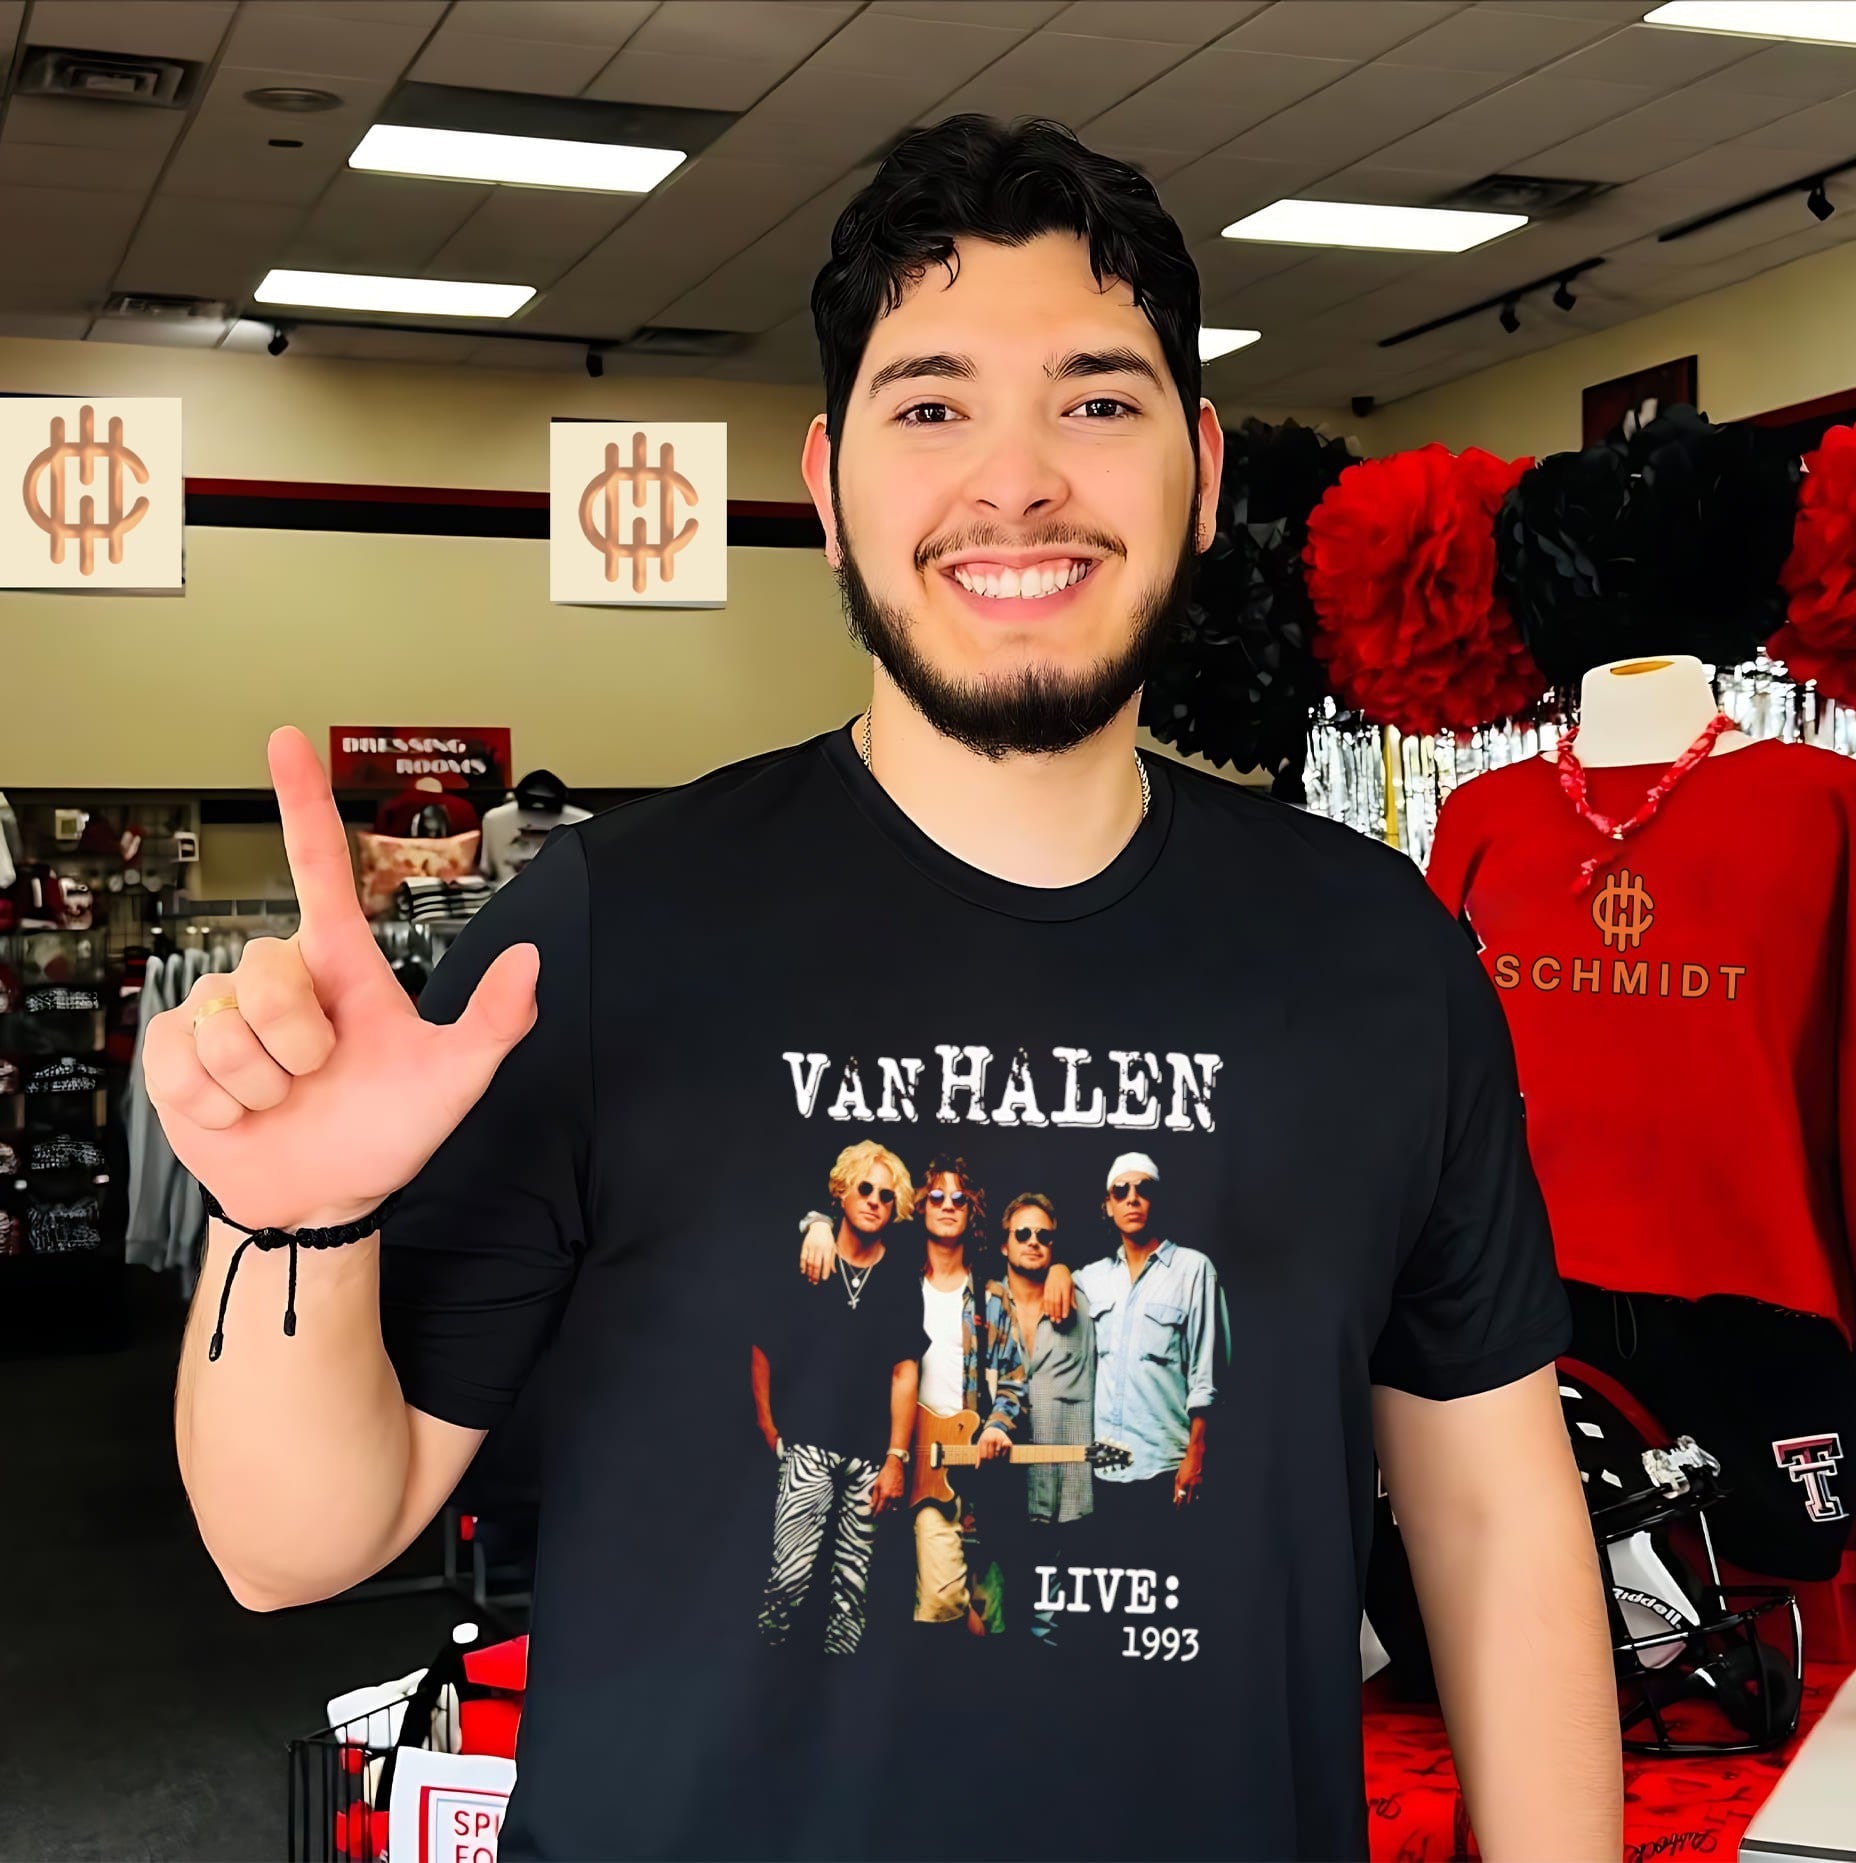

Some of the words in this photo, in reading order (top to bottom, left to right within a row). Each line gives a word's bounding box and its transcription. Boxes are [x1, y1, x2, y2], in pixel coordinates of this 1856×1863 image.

[342, 737, 466, 754] DRESSING
[396, 758, 487, 775] ROOMS
[1494, 954, 1747, 1001] SCHMIDT
[782, 1050, 926, 1123] VAN
[934, 1043, 1223, 1133] HALEN
[1033, 1565, 1180, 1615] LIVE:
[1121, 1626, 1200, 1662] 1993
